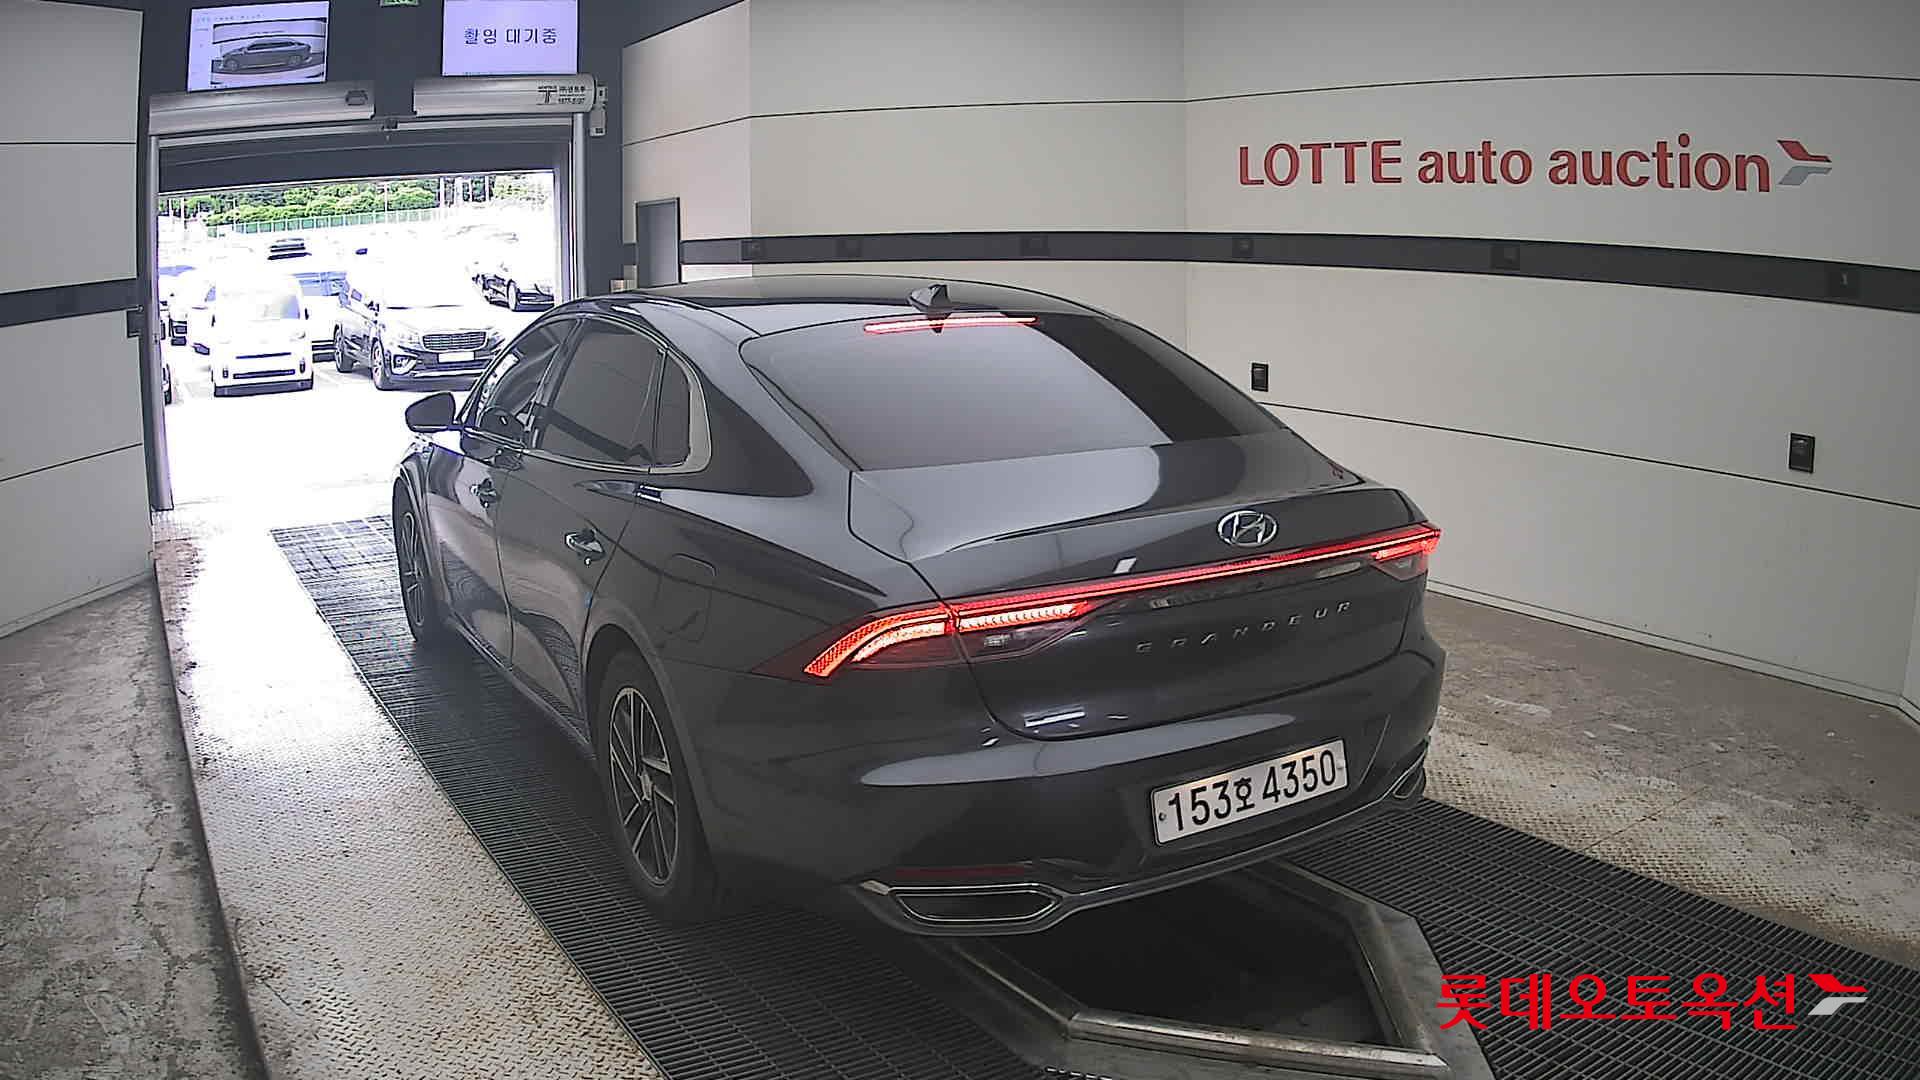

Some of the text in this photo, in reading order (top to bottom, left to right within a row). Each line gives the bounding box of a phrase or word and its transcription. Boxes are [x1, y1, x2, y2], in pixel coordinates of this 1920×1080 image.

[506, 27, 558, 45] 대기중
[1239, 134, 1772, 193] LOTTE auto auction
[1136, 601, 1351, 653] GRANDEUR
[1168, 750, 1337, 832] 153호 4350
